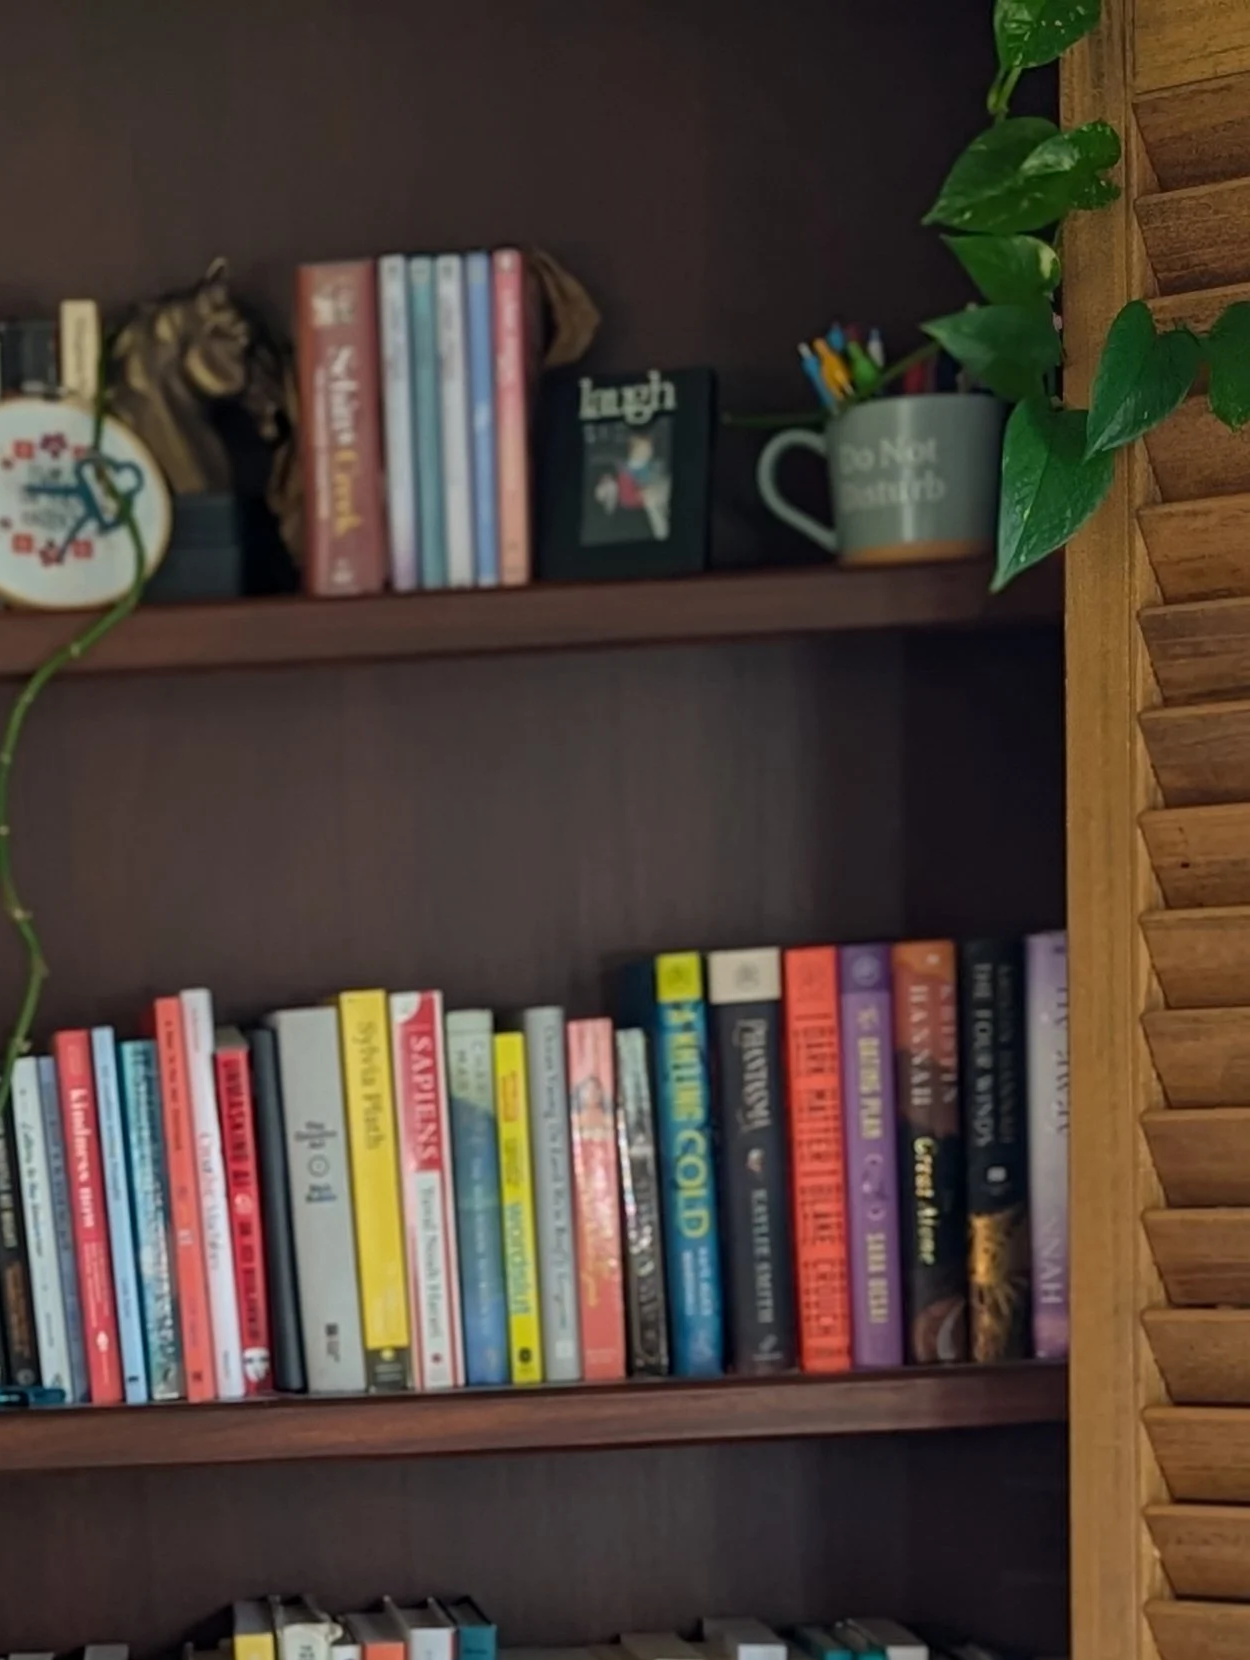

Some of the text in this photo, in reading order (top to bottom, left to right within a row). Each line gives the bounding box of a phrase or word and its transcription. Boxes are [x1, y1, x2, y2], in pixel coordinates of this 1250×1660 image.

[578, 369, 677, 424] laugh
[837, 435, 937, 475] Do Not
[837, 469, 948, 514] Disturb
[351, 1020, 385, 1151] Sylvia Plath
[671, 1032, 703, 1123] KILLING
[909, 985, 933, 1107] HANNAH
[973, 962, 995, 1147] THE FOUR WINDS
[66, 1087, 93, 1184] kindness
[223, 1057, 249, 1164] UNMASKING
[408, 1035, 439, 1161] SAPIENS
[76, 1187, 96, 1229] now
[231, 1169, 251, 1188] AI
[675, 1129, 711, 1240] COLD
[735, 1019, 775, 1324] PHANTASMA KAYLIE SMITH
[856, 1036, 889, 1324] DATING PLAN SARA DESAI
[912, 1135, 938, 1199] Great
[424, 1236, 439, 1280] Noah
[426, 1283, 444, 1339] Harari
